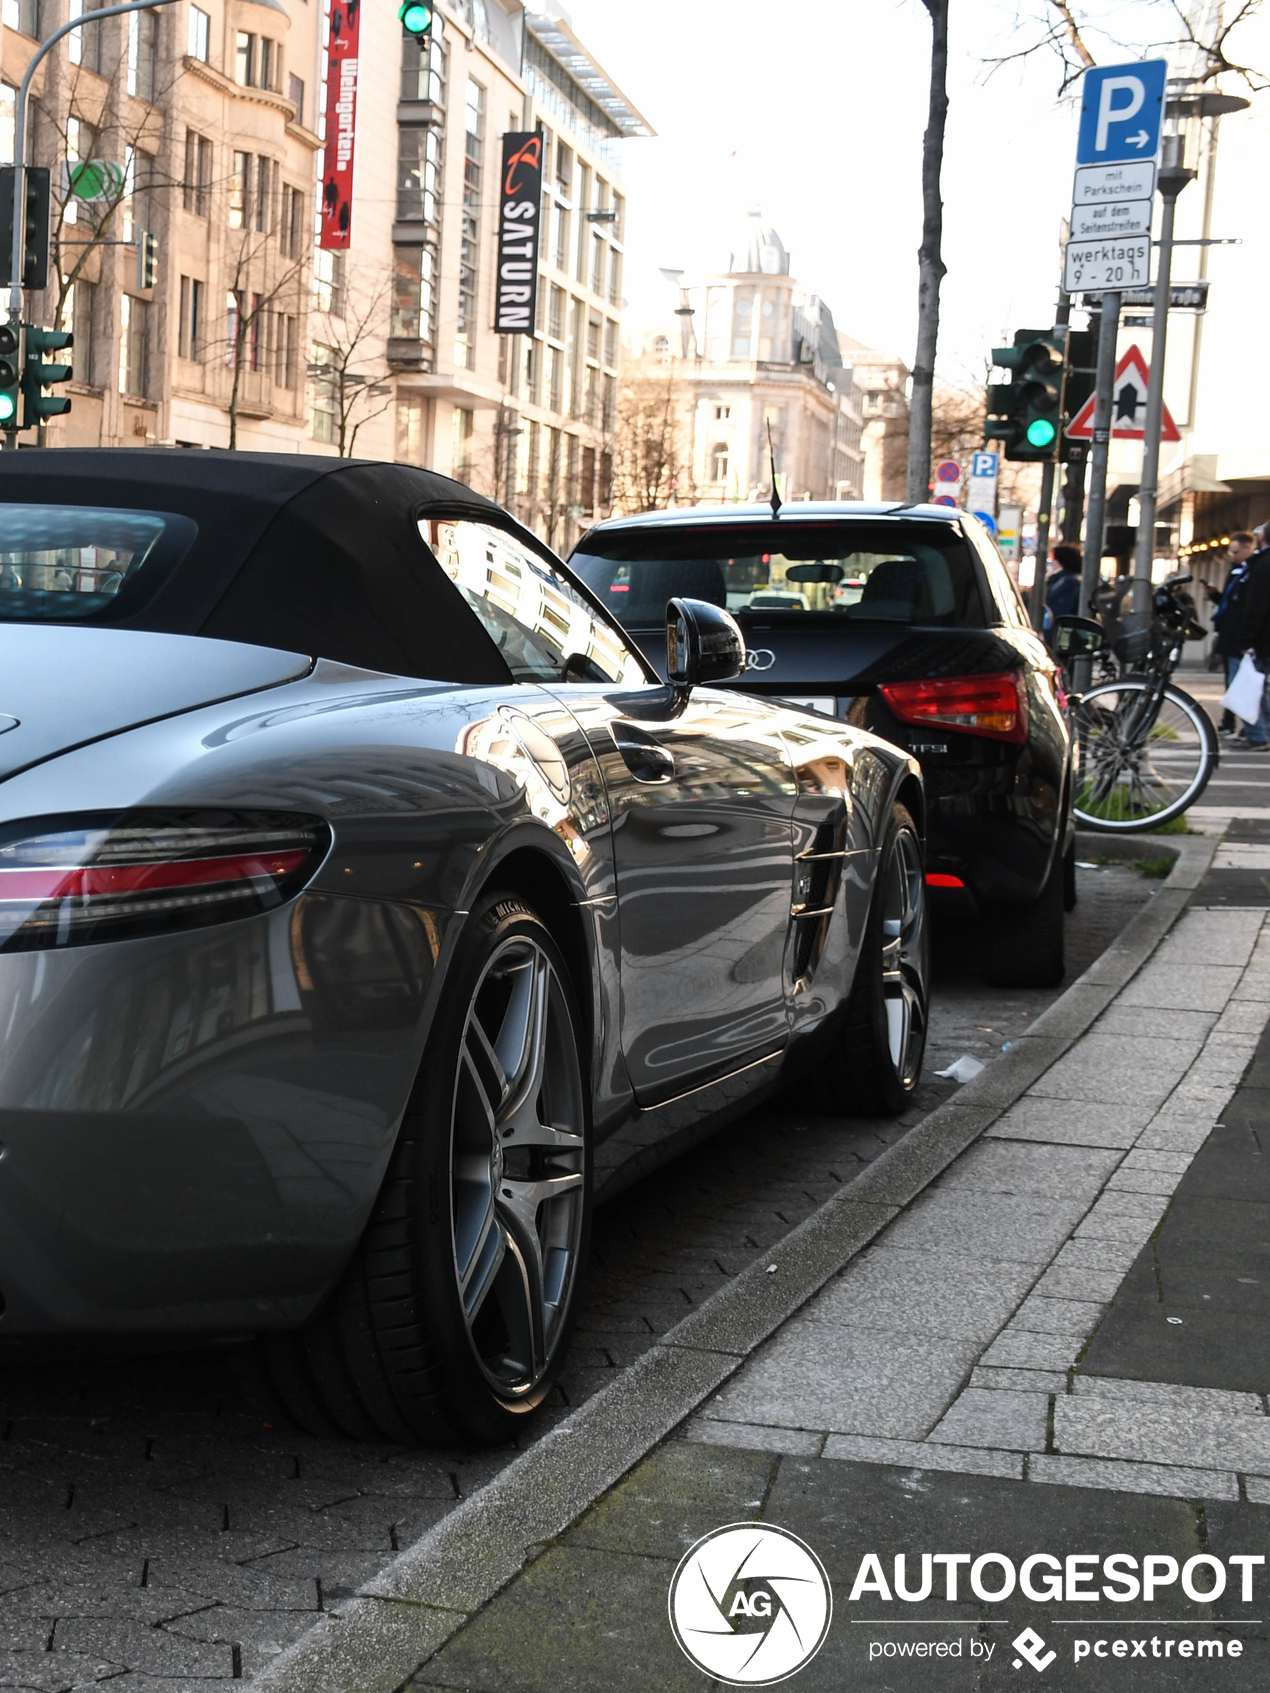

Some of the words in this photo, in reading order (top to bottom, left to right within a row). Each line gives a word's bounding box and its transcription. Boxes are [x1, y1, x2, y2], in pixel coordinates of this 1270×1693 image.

[1095, 75, 1146, 151] P
[1105, 170, 1122, 181] mit
[1084, 182, 1143, 196] Parkschein
[1093, 206, 1107, 219] auf
[1111, 205, 1130, 217] dem
[1080, 219, 1141, 234] Seitenstreifen
[1071, 245, 1145, 265] werktags
[498, 201, 536, 328] SATURN
[1074, 269, 1083, 285] 9
[1105, 266, 1124, 282] 20
[976, 455, 993, 475] P
[908, 744, 948, 753] TFSI
